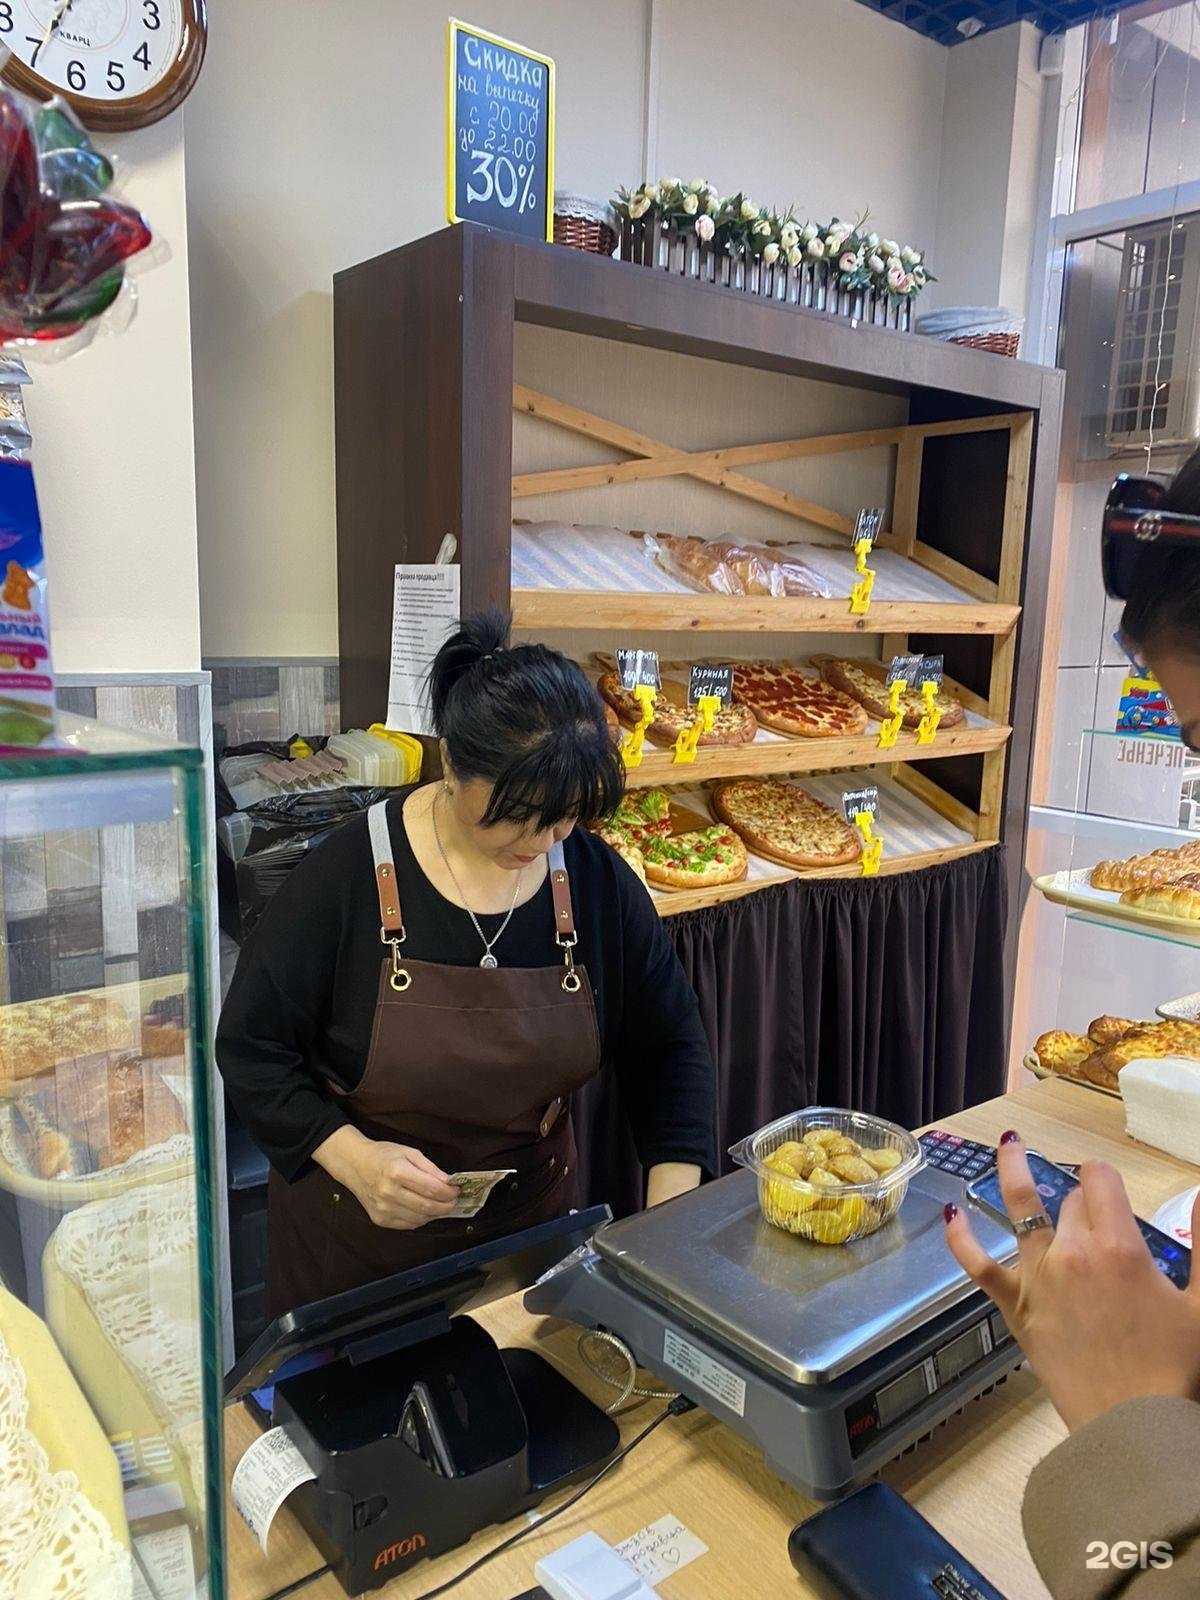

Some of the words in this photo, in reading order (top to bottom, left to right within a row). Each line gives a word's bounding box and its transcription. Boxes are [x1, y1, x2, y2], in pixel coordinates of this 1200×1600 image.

[142, 0, 161, 31] 3
[25, 36, 44, 68] 7
[60, 31, 92, 47] КВАРЦ
[132, 41, 151, 71] 4
[464, 38, 543, 89] Скидка
[66, 60, 86, 91] 6
[106, 60, 126, 92] 5
[457, 74, 479, 96] на
[485, 73, 540, 117] выпечку
[488, 102, 539, 138] 20.00
[459, 127, 476, 151] до
[484, 131, 536, 162] 22.00
[466, 149, 536, 214] 30%
[692, 667, 729, 680] КУРИНАЯ
